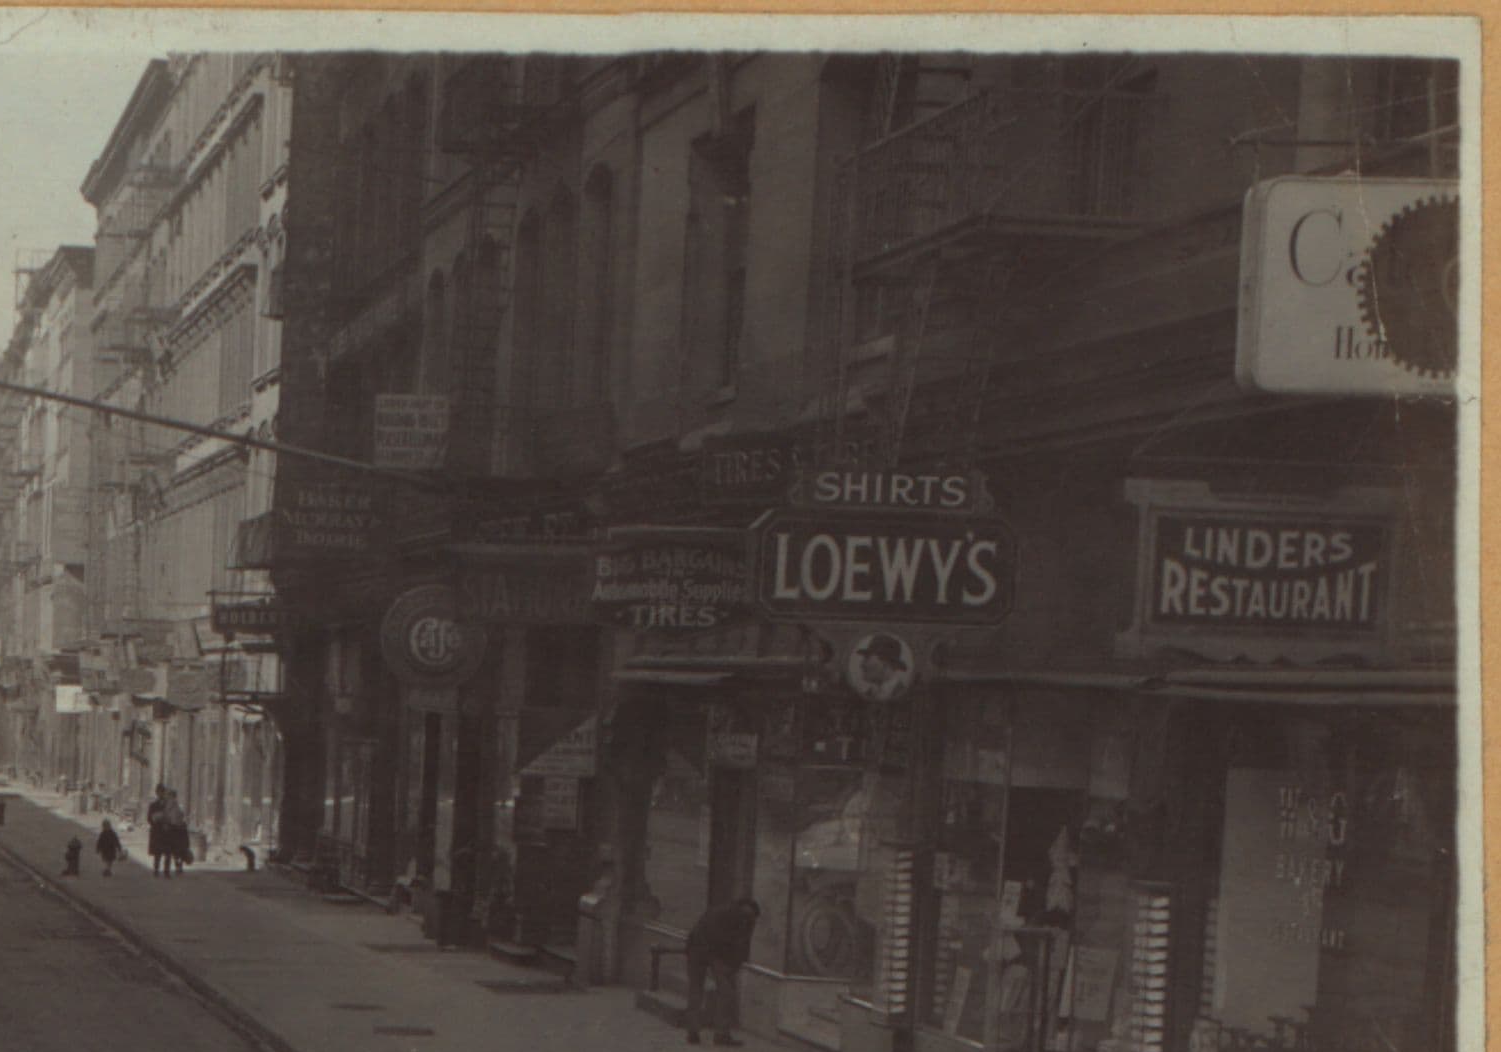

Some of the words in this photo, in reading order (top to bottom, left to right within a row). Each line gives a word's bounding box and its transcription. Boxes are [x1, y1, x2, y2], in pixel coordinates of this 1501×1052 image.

[712, 448, 782, 485] TIRES
[815, 472, 967, 506] SHIRTS
[772, 531, 998, 605] LOEWY'S
[1184, 525, 1354, 569] LINDERS
[1160, 557, 1377, 621] RESTAURANT
